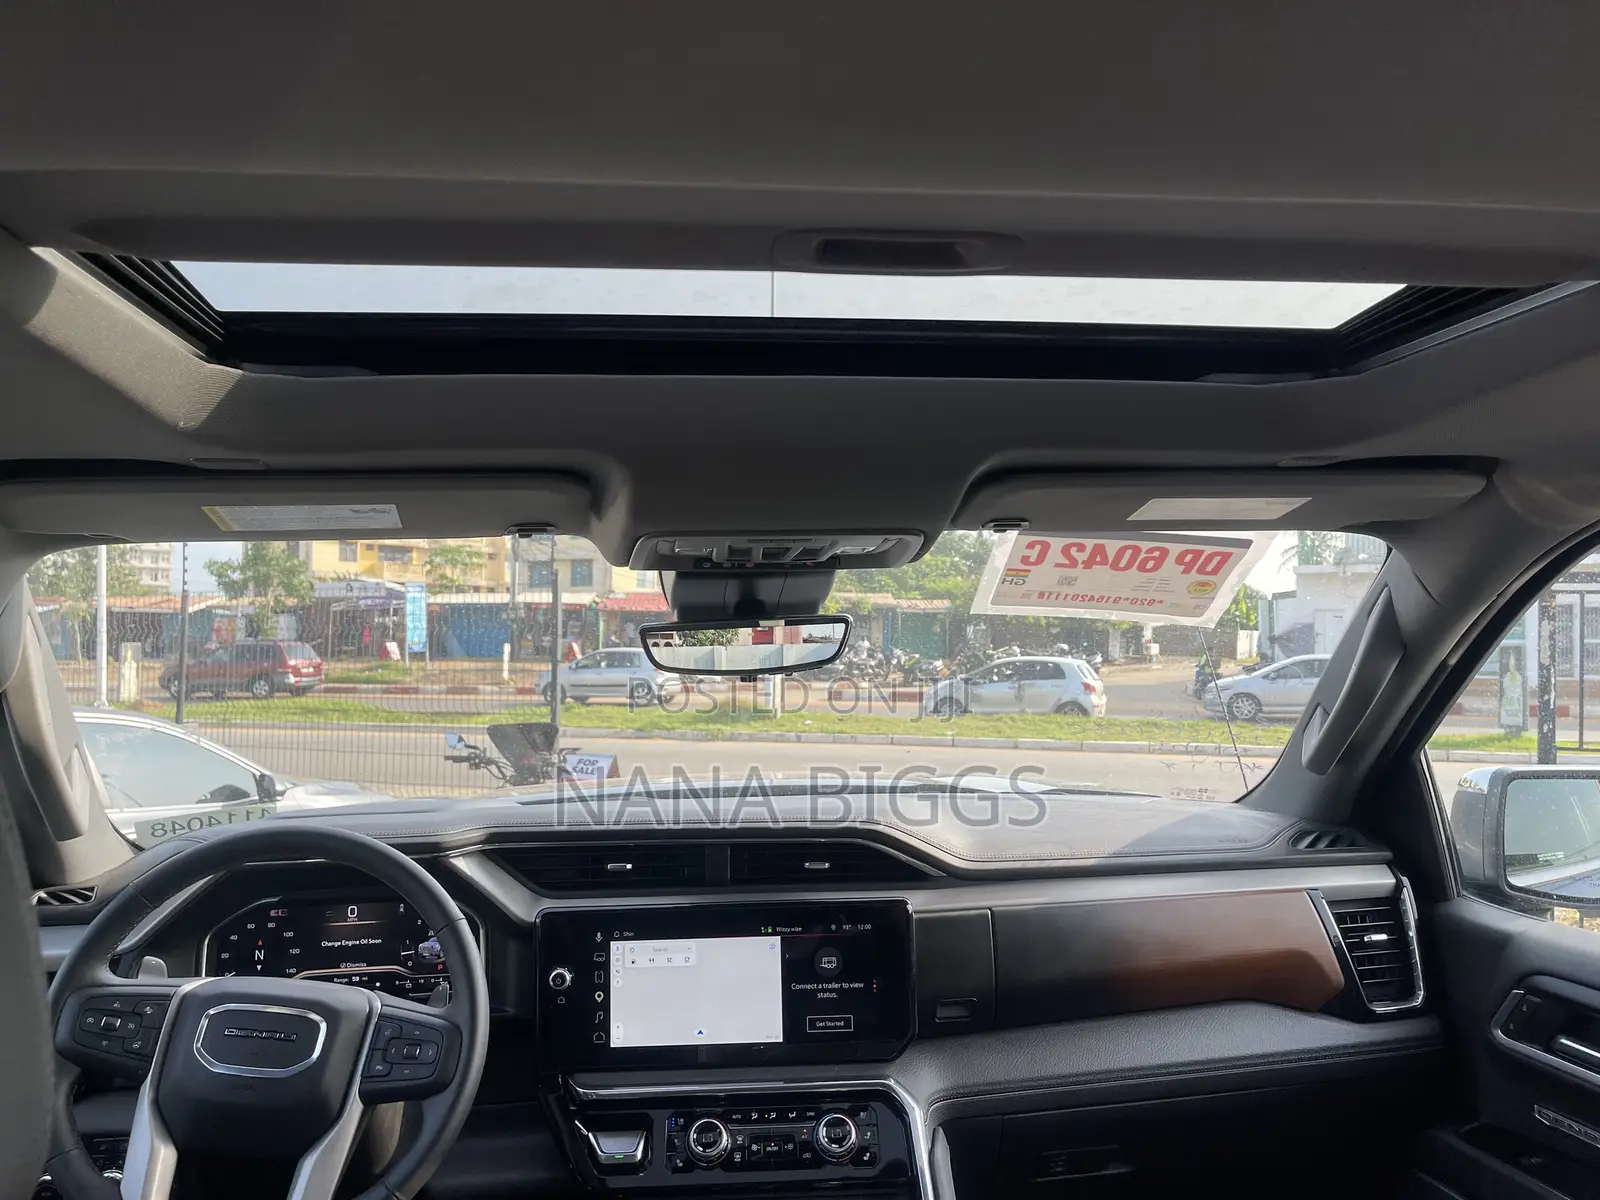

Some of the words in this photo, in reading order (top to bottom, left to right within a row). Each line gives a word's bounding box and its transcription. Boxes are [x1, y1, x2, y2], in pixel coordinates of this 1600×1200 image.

[576, 758, 599, 767] FOR
[572, 766, 598, 775] SALE
[347, 905, 358, 918] 0
[321, 940, 342, 948] Change
[342, 939, 360, 947] Engine
[254, 949, 264, 961] N
[791, 982, 817, 990] Connect
[823, 981, 842, 989] trailer
[817, 991, 839, 999] status.
[224, 1028, 298, 1041] DENALI
